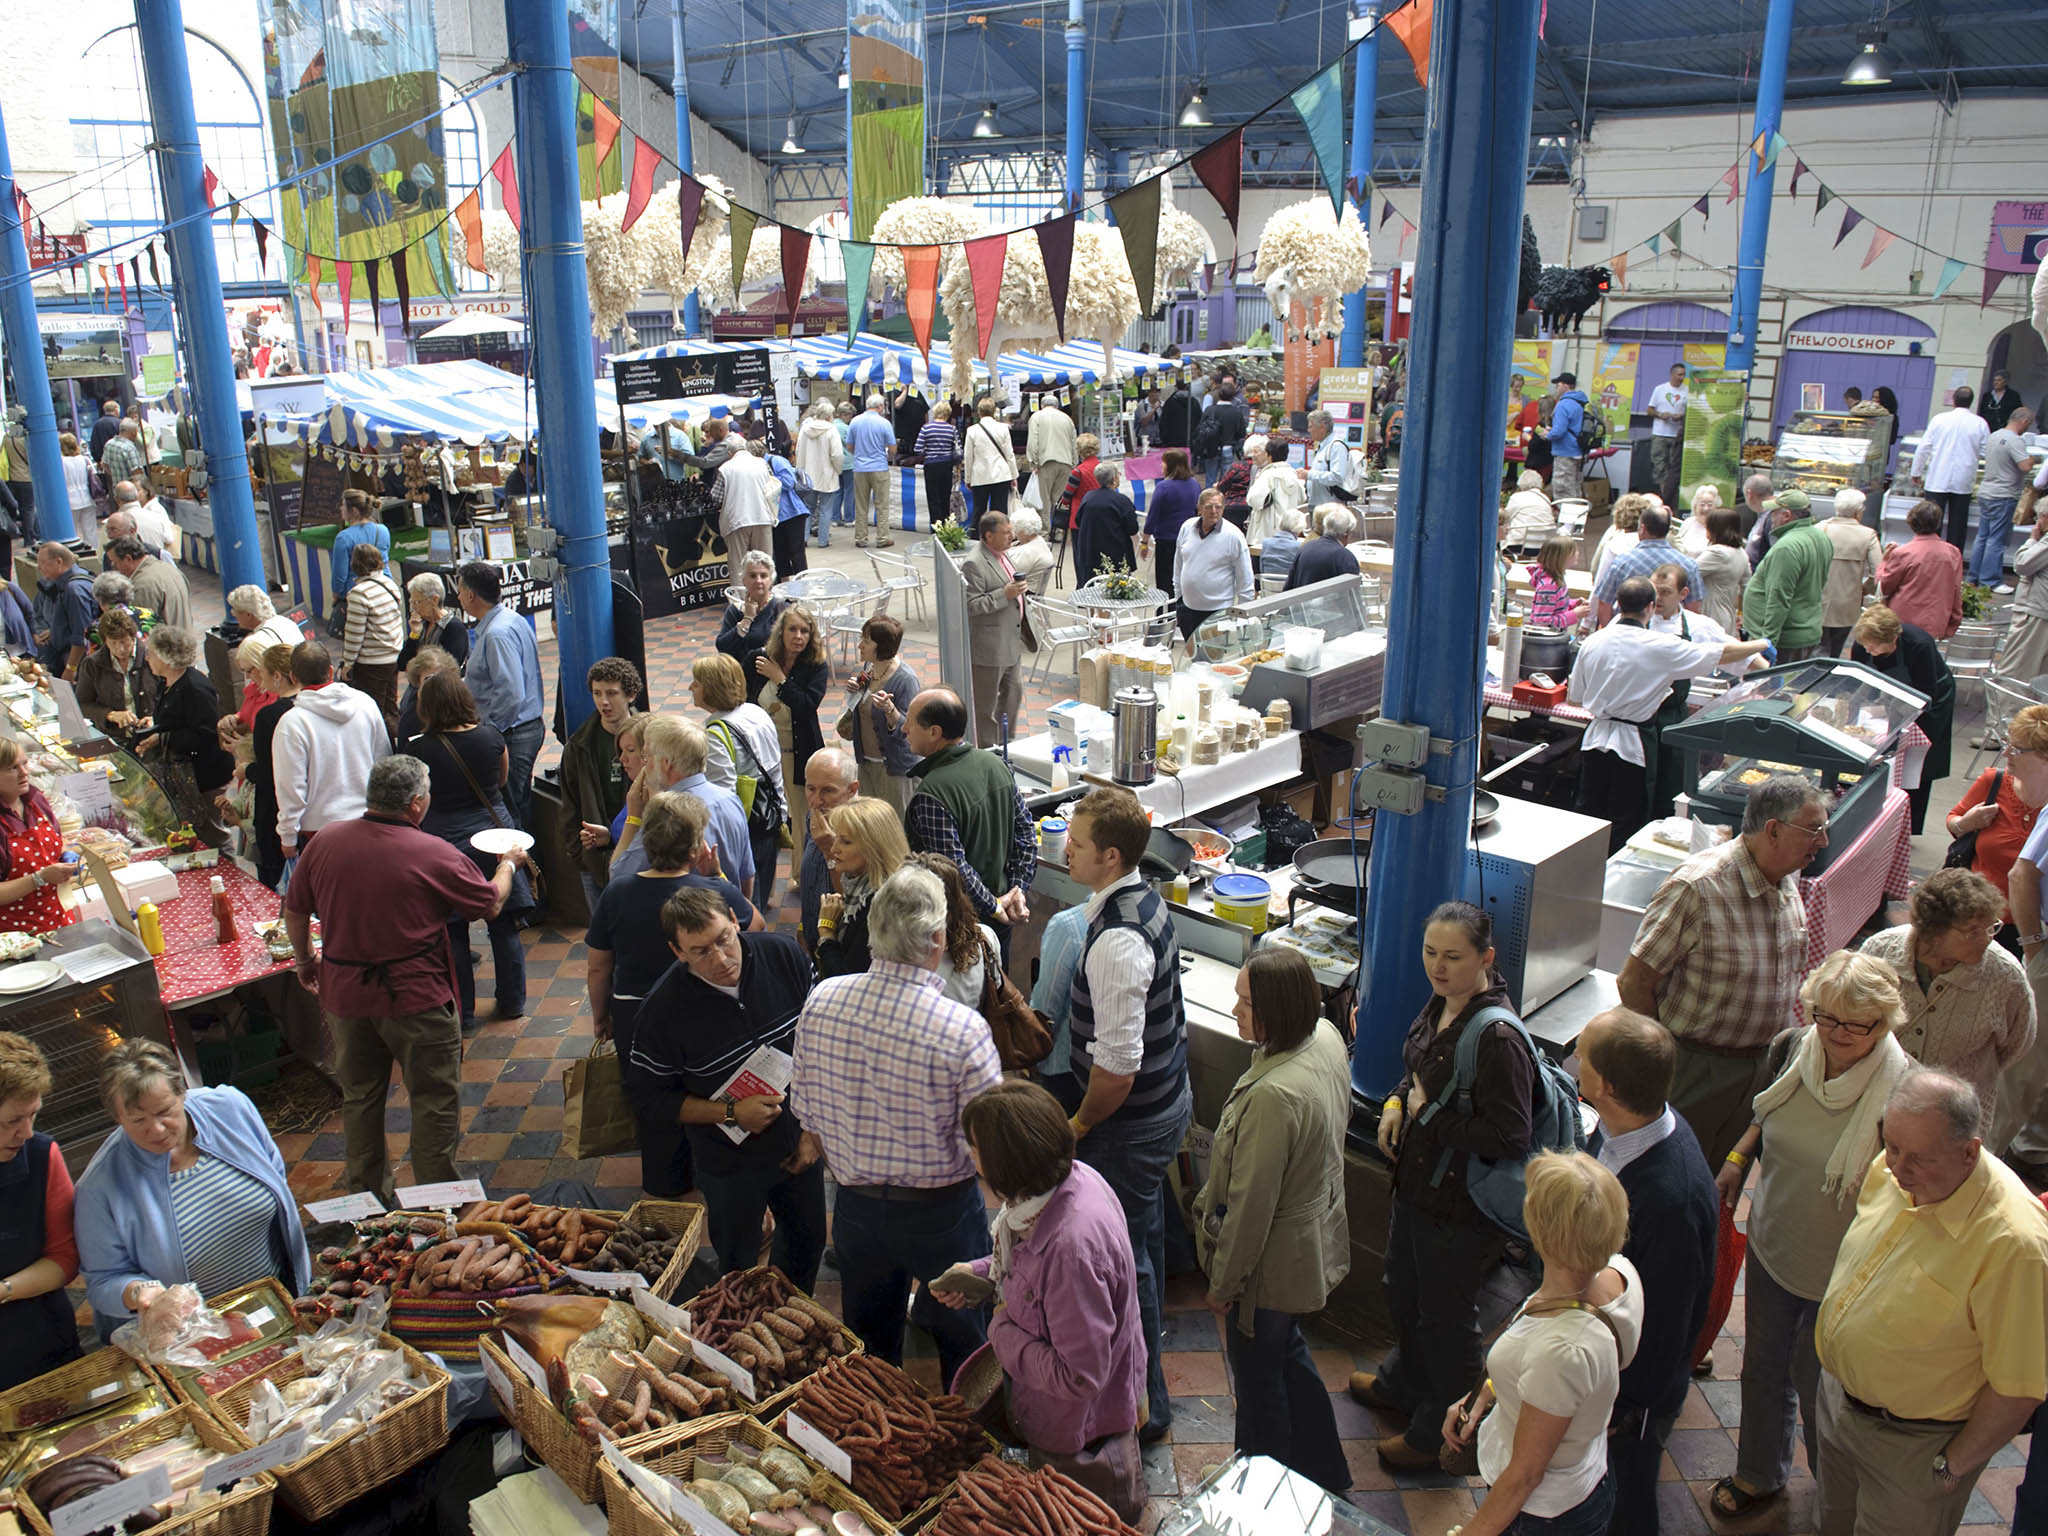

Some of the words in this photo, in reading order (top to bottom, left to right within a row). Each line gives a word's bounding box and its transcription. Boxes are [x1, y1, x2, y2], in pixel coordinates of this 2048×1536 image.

[2024, 204, 2045, 220] THE
[407, 305, 444, 317] HOT
[449, 307, 458, 315] &
[40, 321, 73, 331] alley
[681, 378, 715, 388] KINGSTONE
[686, 387, 712, 395] BREWERY
[765, 407, 776, 452] REAL
[669, 564, 729, 591] KINGSTO
[501, 586, 522, 596] NNER
[523, 581, 534, 591] OF
[524, 586, 552, 608] THE
[680, 588, 726, 606] BREWE
